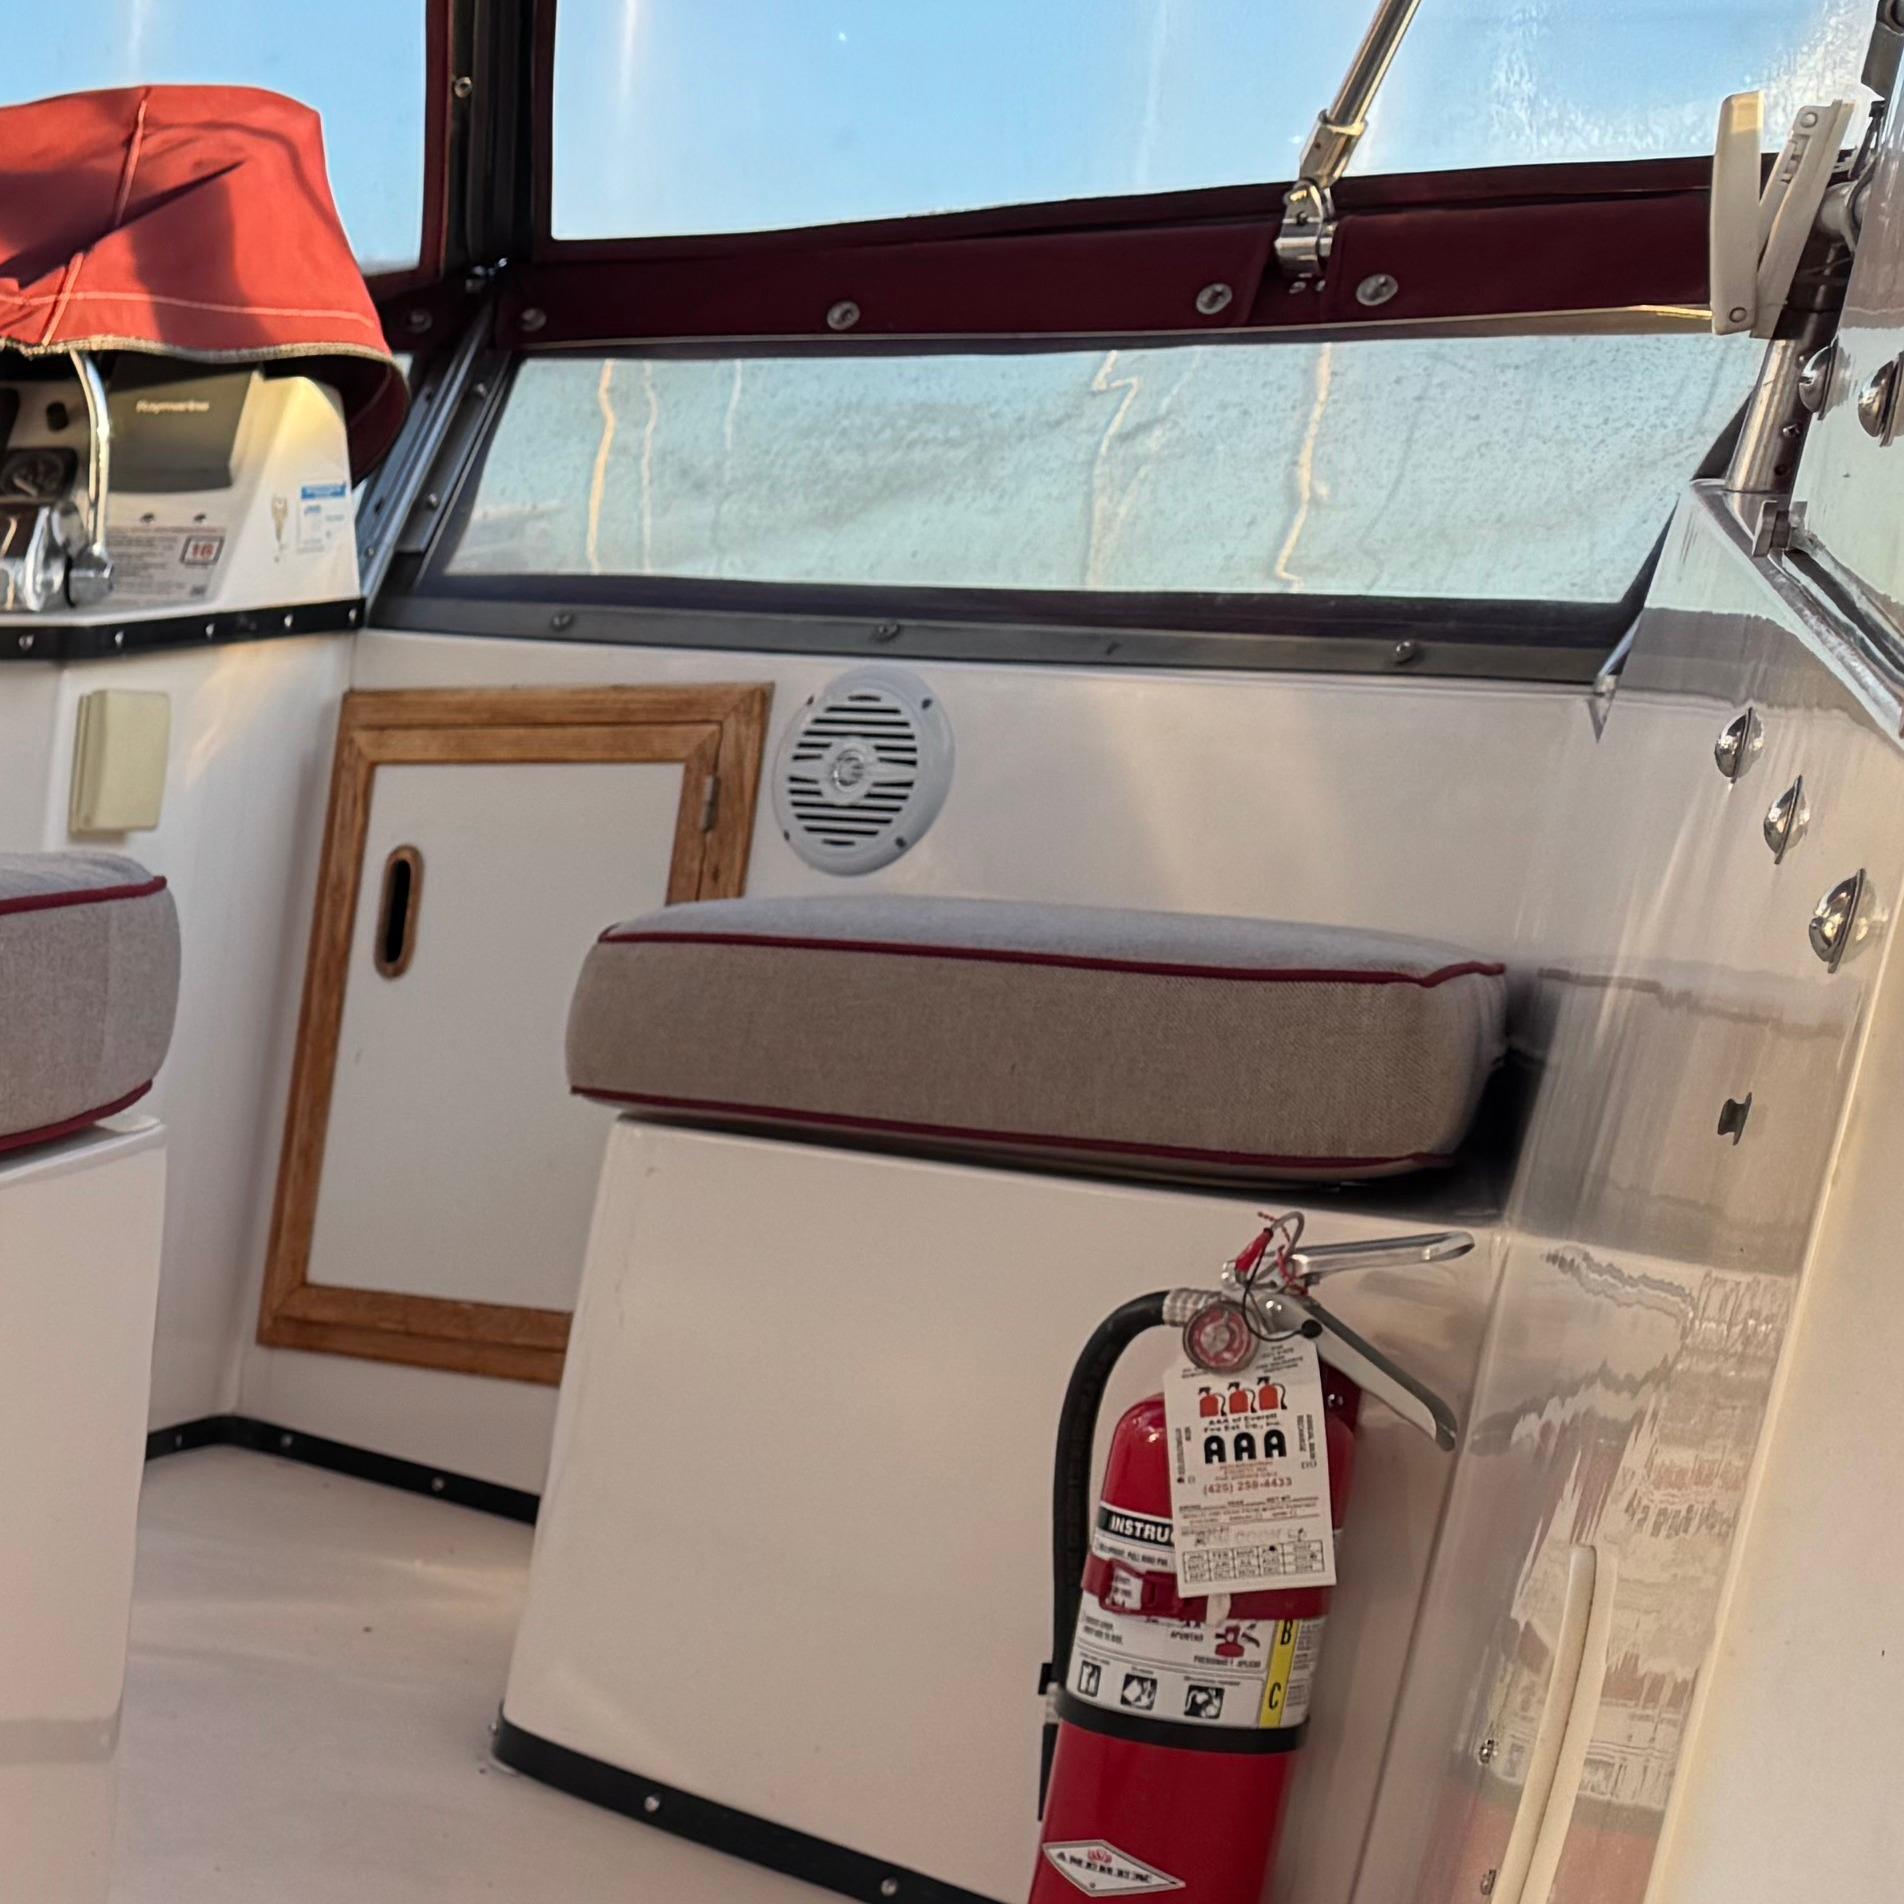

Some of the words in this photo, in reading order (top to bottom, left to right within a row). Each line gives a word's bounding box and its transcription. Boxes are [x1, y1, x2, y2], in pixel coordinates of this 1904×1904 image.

[1244, 1413, 1278, 1422] Everett
[1204, 1429, 1287, 1464] AAA
[1203, 1483, 1234, 1496] (425)
[1280, 1619, 1293, 1646] B
[1268, 1681, 1282, 1710] C
